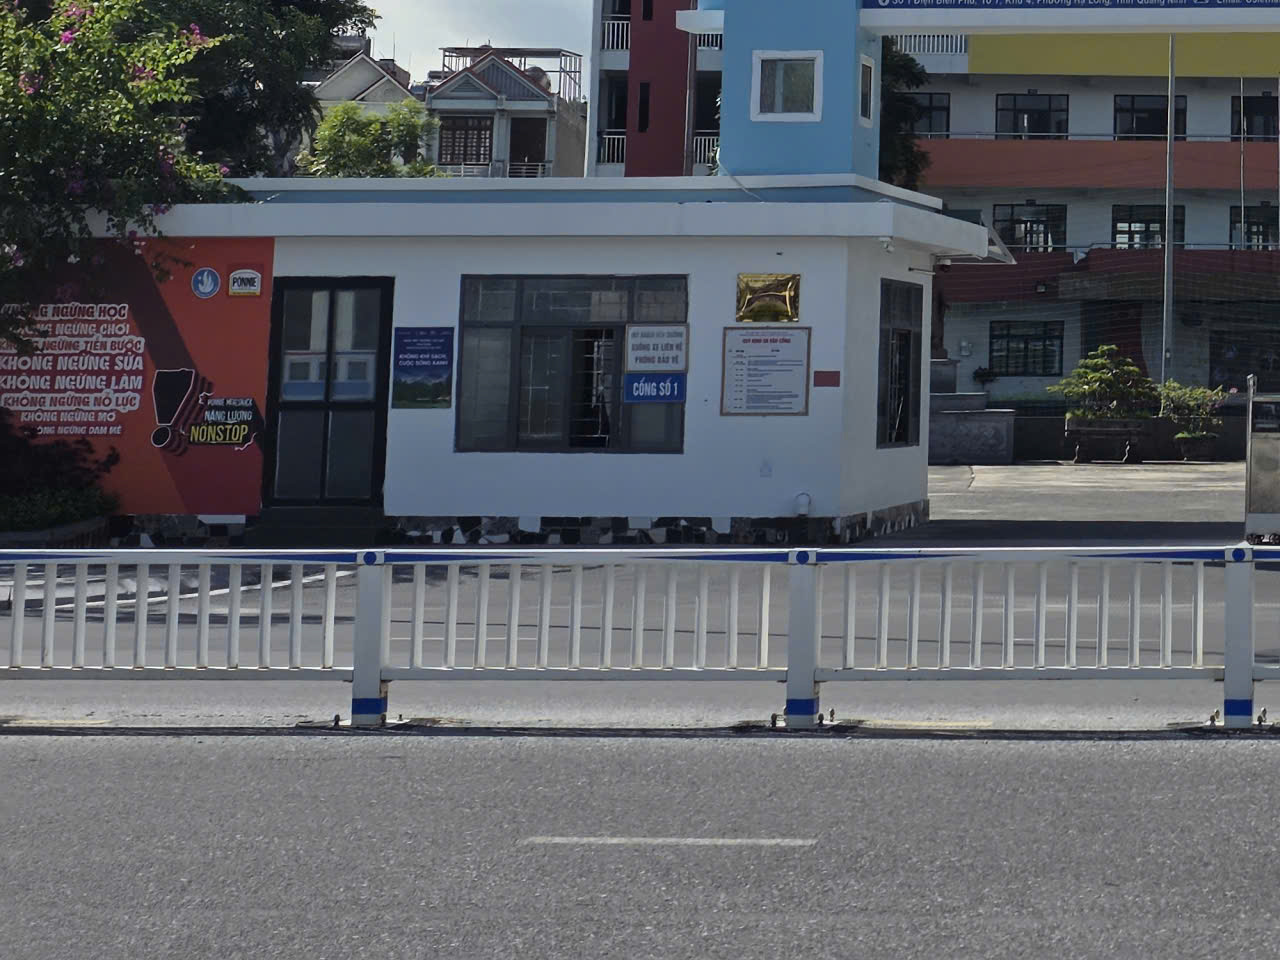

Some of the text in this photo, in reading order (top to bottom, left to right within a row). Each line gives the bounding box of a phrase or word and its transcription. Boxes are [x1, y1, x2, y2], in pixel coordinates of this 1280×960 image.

[98, 305, 127, 319] HỌC
[56, 353, 110, 370] NGỪNG
[0, 372, 143, 390] KHÔNG NGỪNG LÀM
[659, 377, 672, 396] SỐ
[673, 382, 679, 396] 1
[3, 393, 46, 407] KHÔNG
[49, 394, 90, 407] NGỪNG
